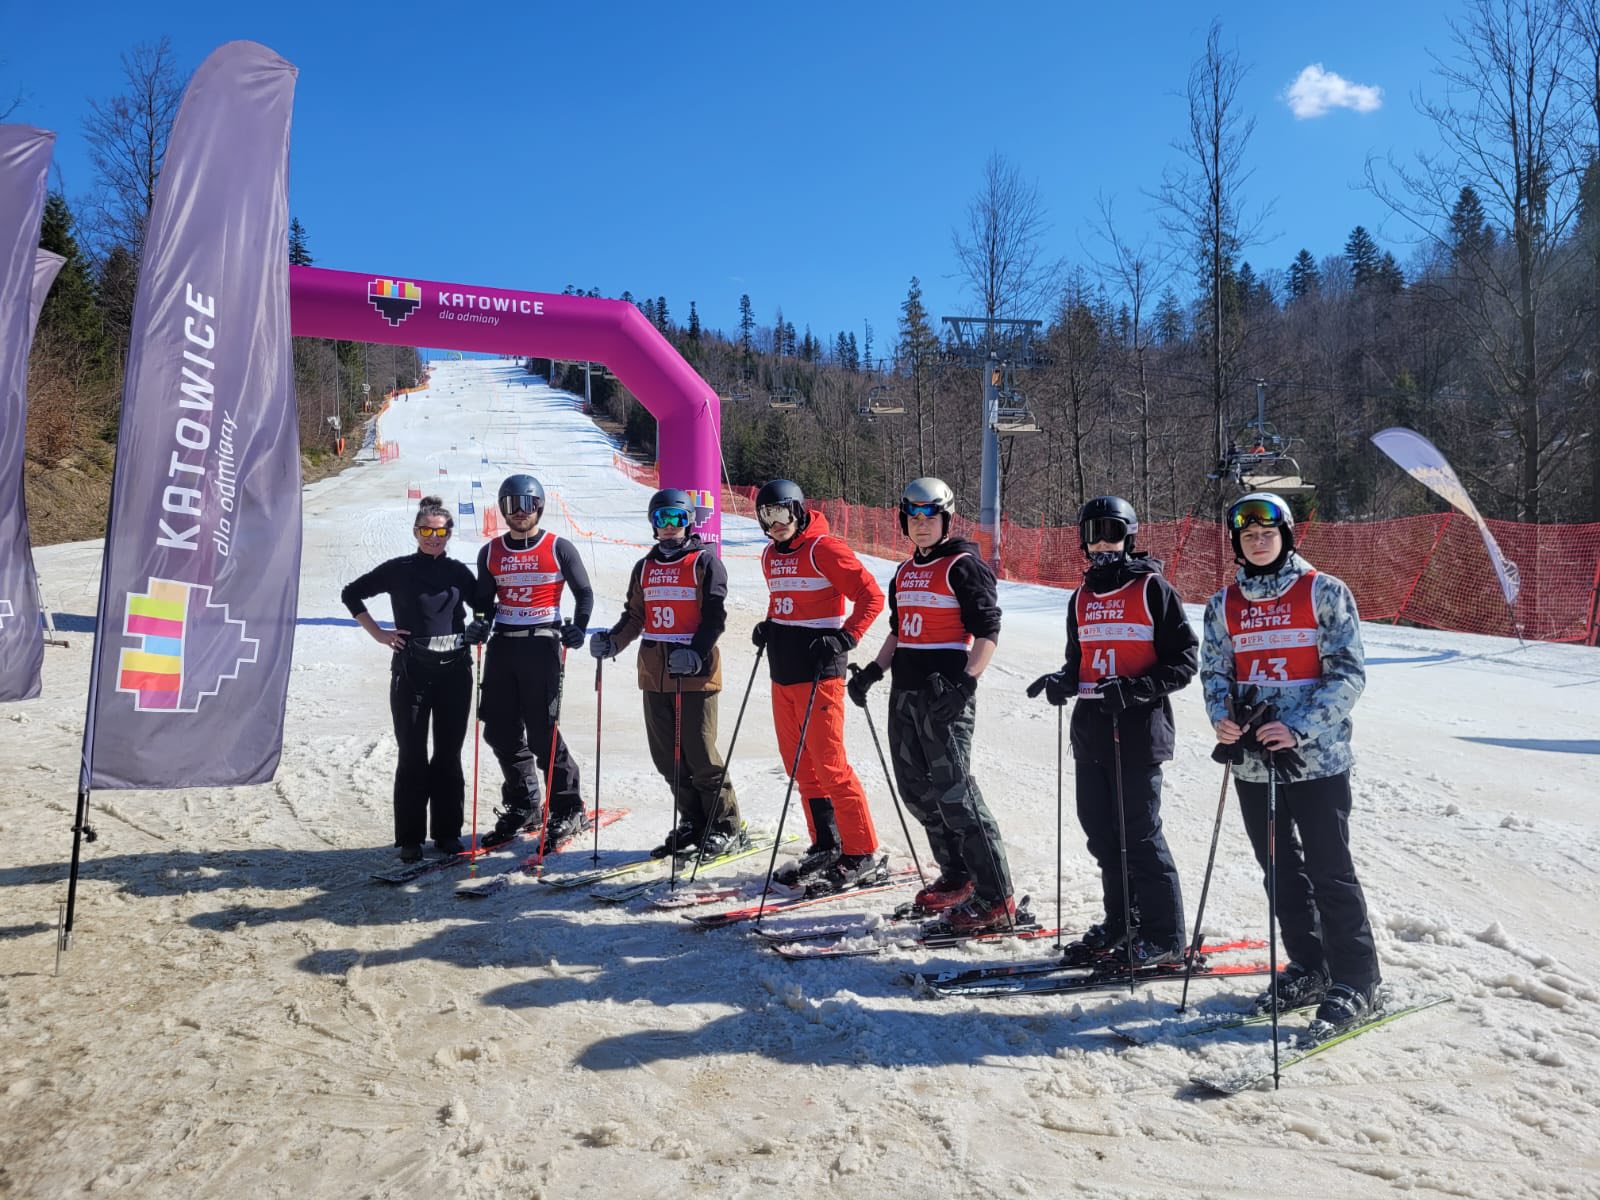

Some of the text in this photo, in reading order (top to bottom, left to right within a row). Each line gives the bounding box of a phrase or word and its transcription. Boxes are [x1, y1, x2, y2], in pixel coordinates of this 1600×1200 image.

[438, 291, 544, 315] KATOWICE
[438, 310, 499, 326] dla odmiany
[156, 283, 215, 550] KATOWICE
[213, 410, 238, 556] dla odmiany
[500, 563, 539, 571] MISTRZ
[770, 566, 798, 575] MISTRZ
[648, 576, 679, 584] MISTRZ
[900, 579, 930, 588] MISTRZ
[505, 587, 533, 602] 42
[774, 597, 794, 615] 38
[1085, 609, 1124, 621] MISTRZ
[652, 606, 675, 628] 39
[901, 613, 923, 637] 40
[1240, 614, 1291, 630] MISTRZ
[428, 633, 464, 652] NIKE
[1091, 648, 1116, 675] 41
[1248, 657, 1289, 681] 43
